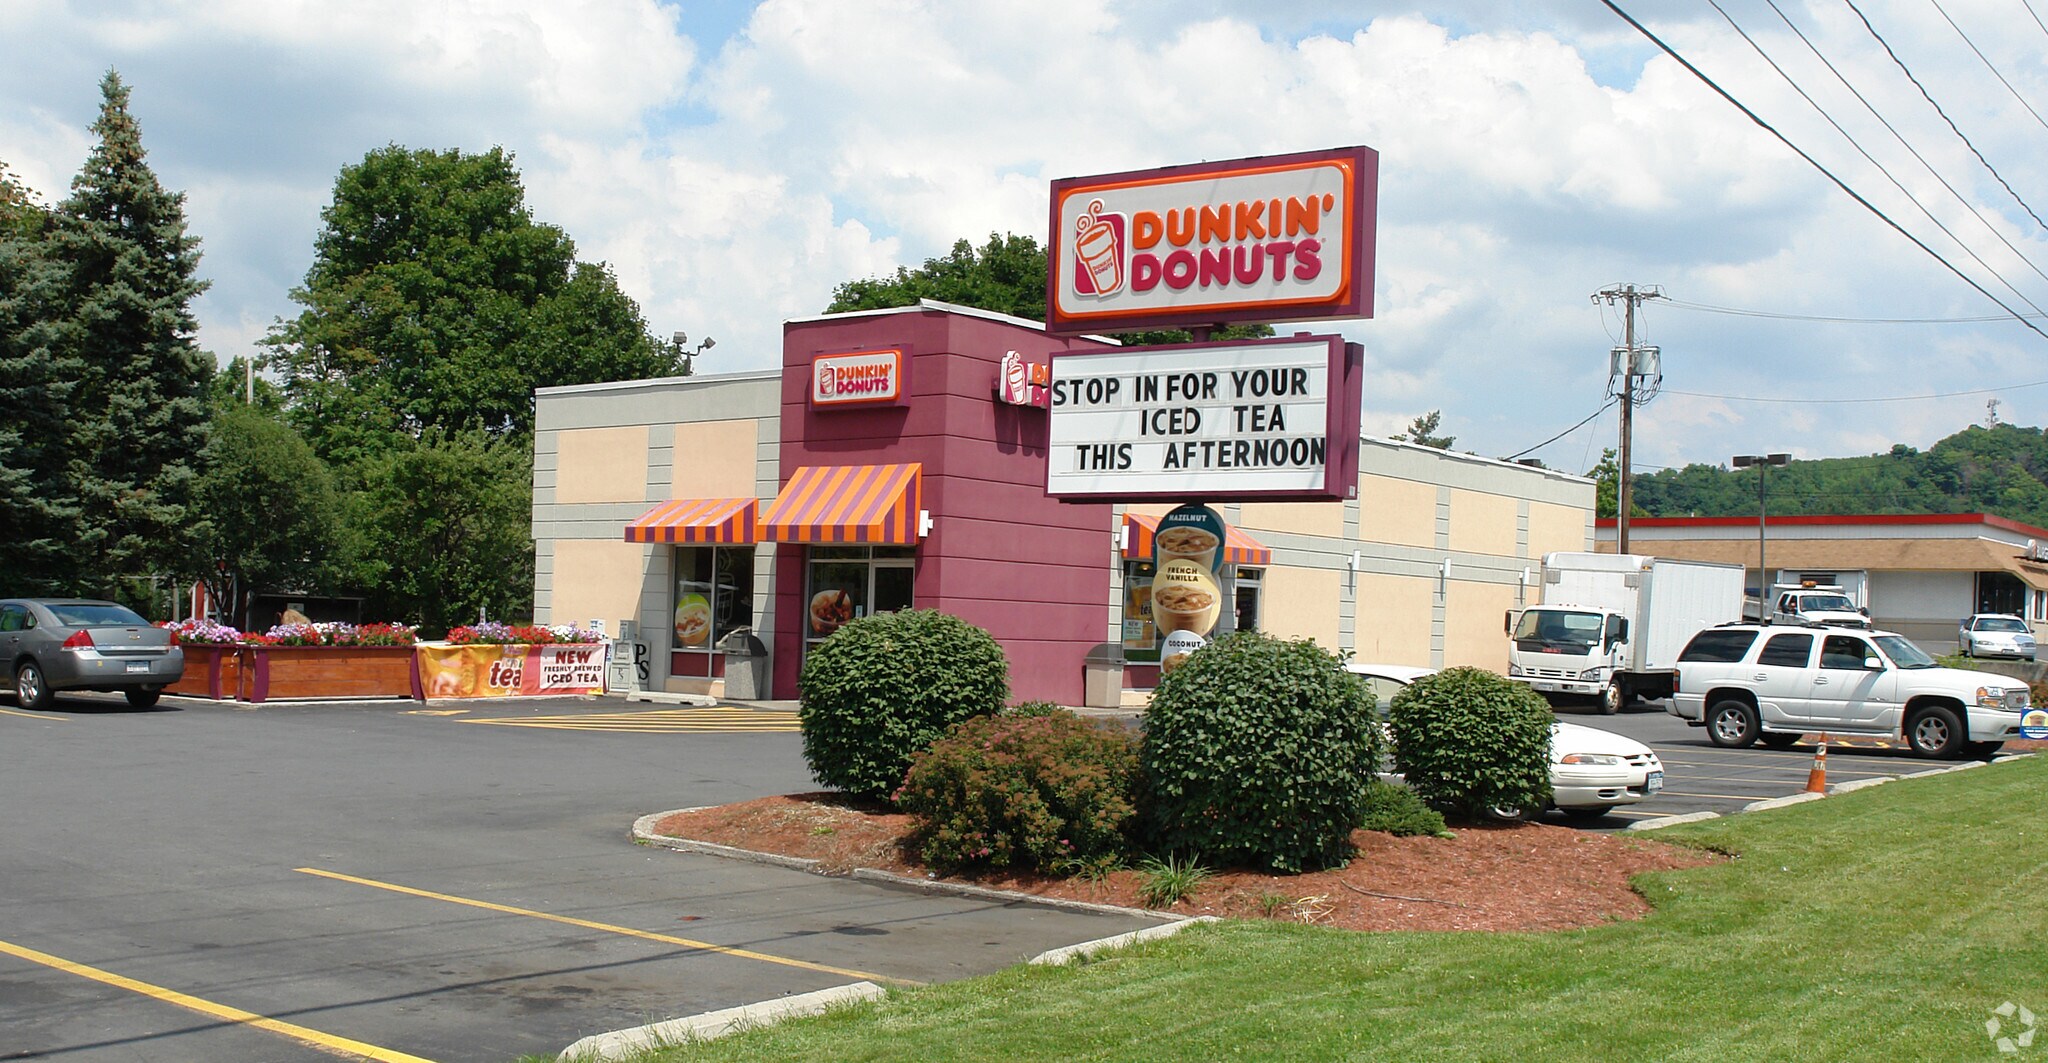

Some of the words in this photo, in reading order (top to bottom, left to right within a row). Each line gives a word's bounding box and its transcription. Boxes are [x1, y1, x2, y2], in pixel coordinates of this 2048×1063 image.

[1132, 193, 1334, 249] DUNKIN'
[1131, 238, 1322, 292] DONUTS
[836, 363, 892, 380] DUNKIN'
[836, 377, 889, 395] DONUTS
[1053, 377, 1120, 406] STOP
[1136, 375, 1158, 402] IN
[1167, 372, 1218, 400] FOR
[1231, 368, 1308, 398] YOUR
[1141, 407, 1201, 436] ICED
[1233, 405, 1285, 432] TEA
[1077, 443, 1132, 470] THIS
[1163, 438, 1325, 469] AFTERNOON
[1168, 514, 1207, 522] HAZELNUT
[1166, 574, 1199, 582] VANILLA
[1168, 640, 1201, 648] COCONUT
[555, 650, 592, 664] NEW
[490, 661, 522, 688] tea
[547, 673, 573, 683] ICED
[576, 673, 598, 683] TEA
